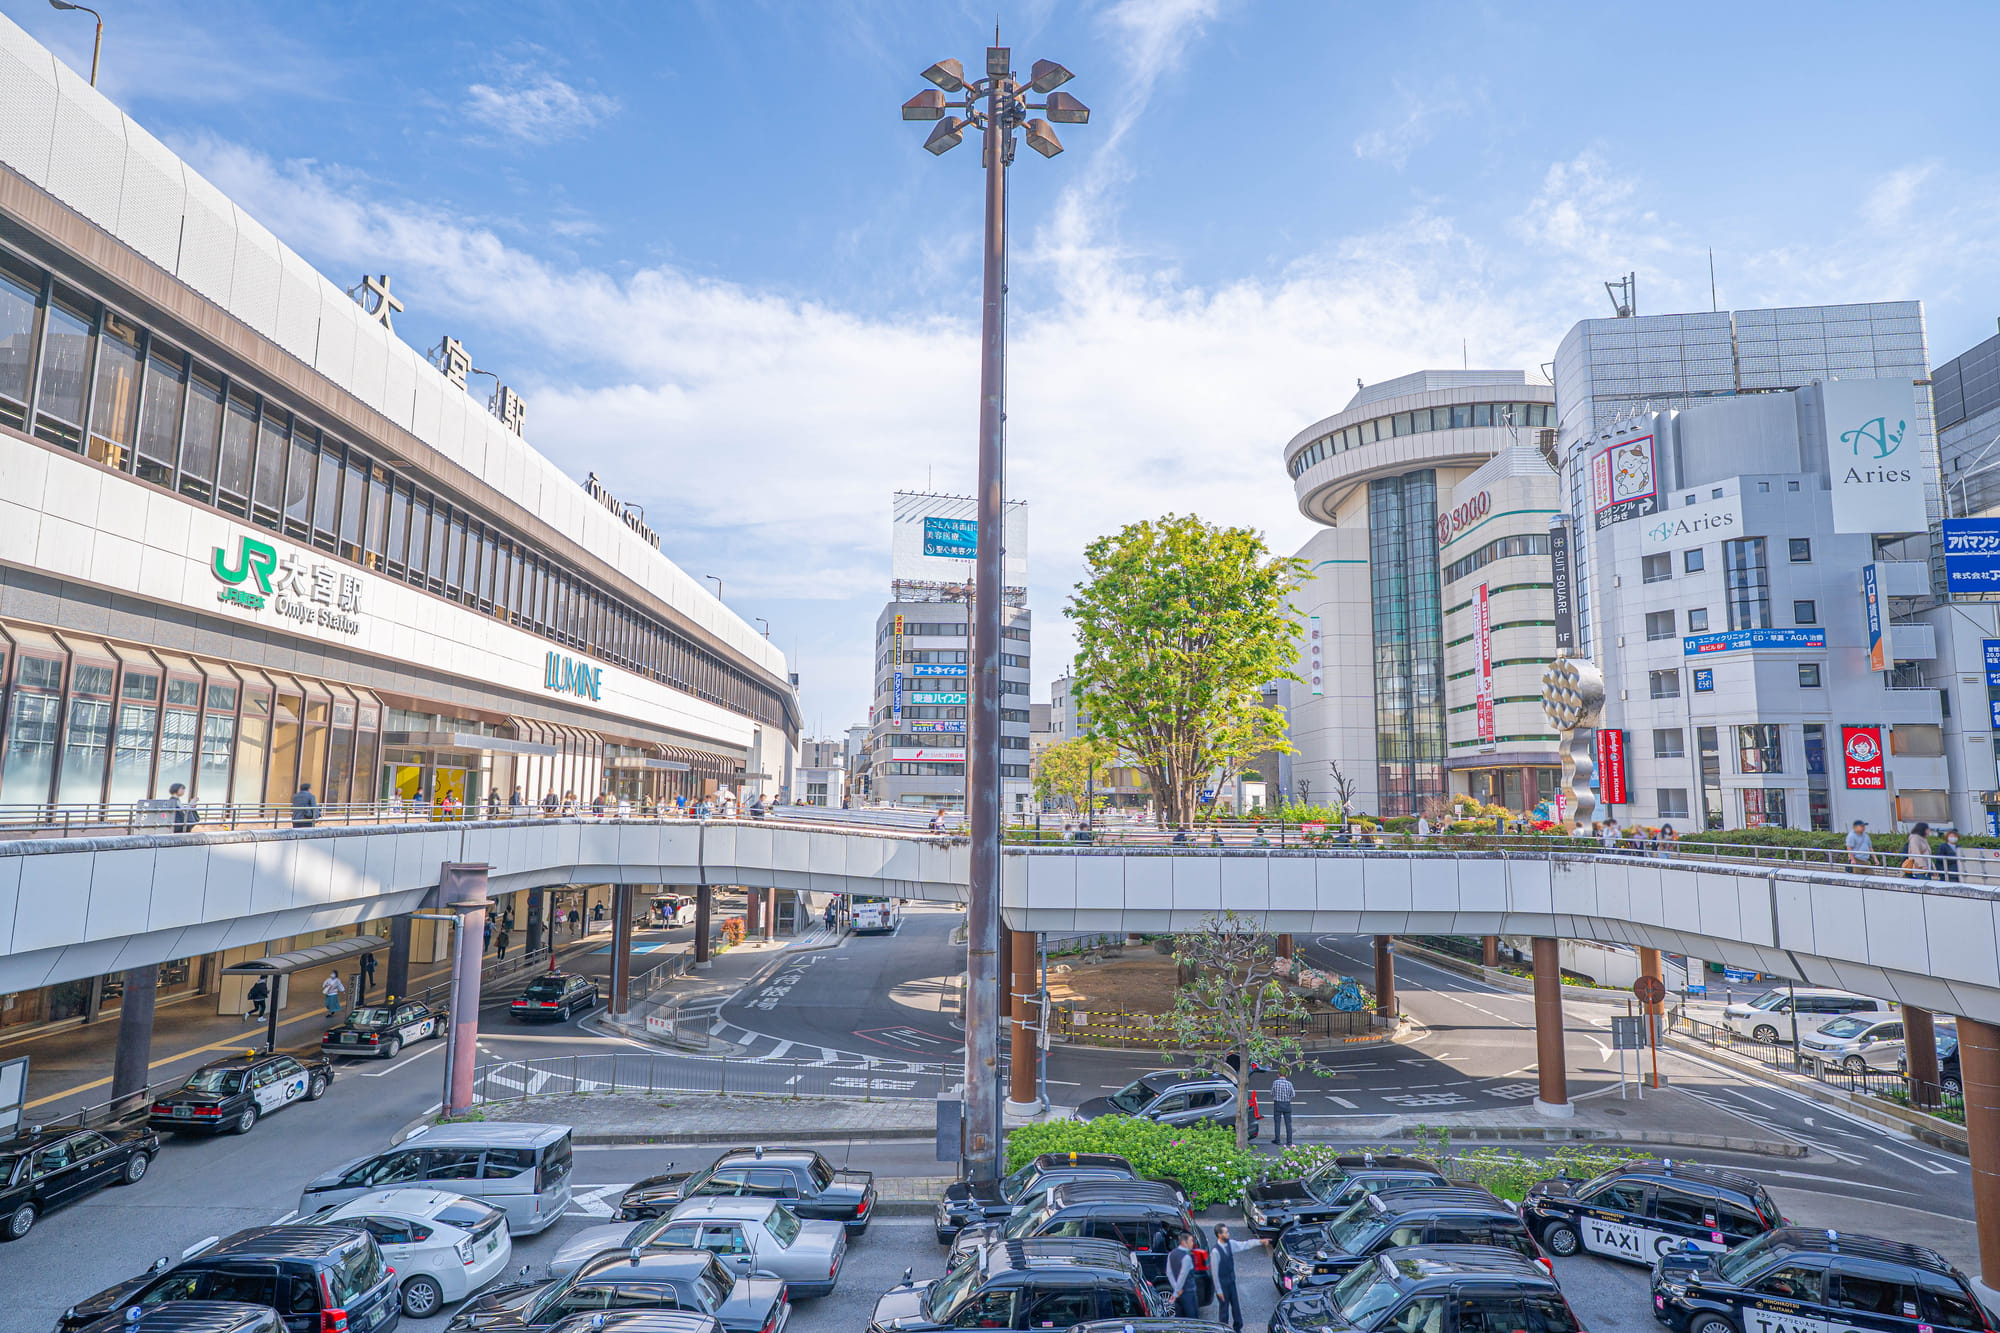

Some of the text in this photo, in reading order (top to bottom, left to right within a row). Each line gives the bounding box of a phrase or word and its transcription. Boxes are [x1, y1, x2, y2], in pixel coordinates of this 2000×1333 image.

[361, 274, 527, 439] 大宮駅
[1843, 466, 1911, 484] Aries
[1453, 491, 1490, 531] SOGO
[1674, 512, 1733, 536] Aries
[624, 509, 660, 550] STATION
[1948, 535, 2000, 549] アパマンシ
[211, 535, 277, 597] JR
[277, 553, 364, 616] 大宮駅
[1555, 550, 1568, 615] SUIT SQUARE
[318, 606, 361, 635] Station
[1558, 633, 1570, 642] 1F
[1698, 632, 1751, 644] ユニティクリニック
[1311, 629, 1321, 686] SOGO
[544, 650, 603, 702] LUMINE
[913, 693, 967, 704] 東進ハイスクー
[1851, 777, 1881, 785] 100席
[286, 1080, 304, 1101] GO
[1591, 1226, 1639, 1252] TAXI
